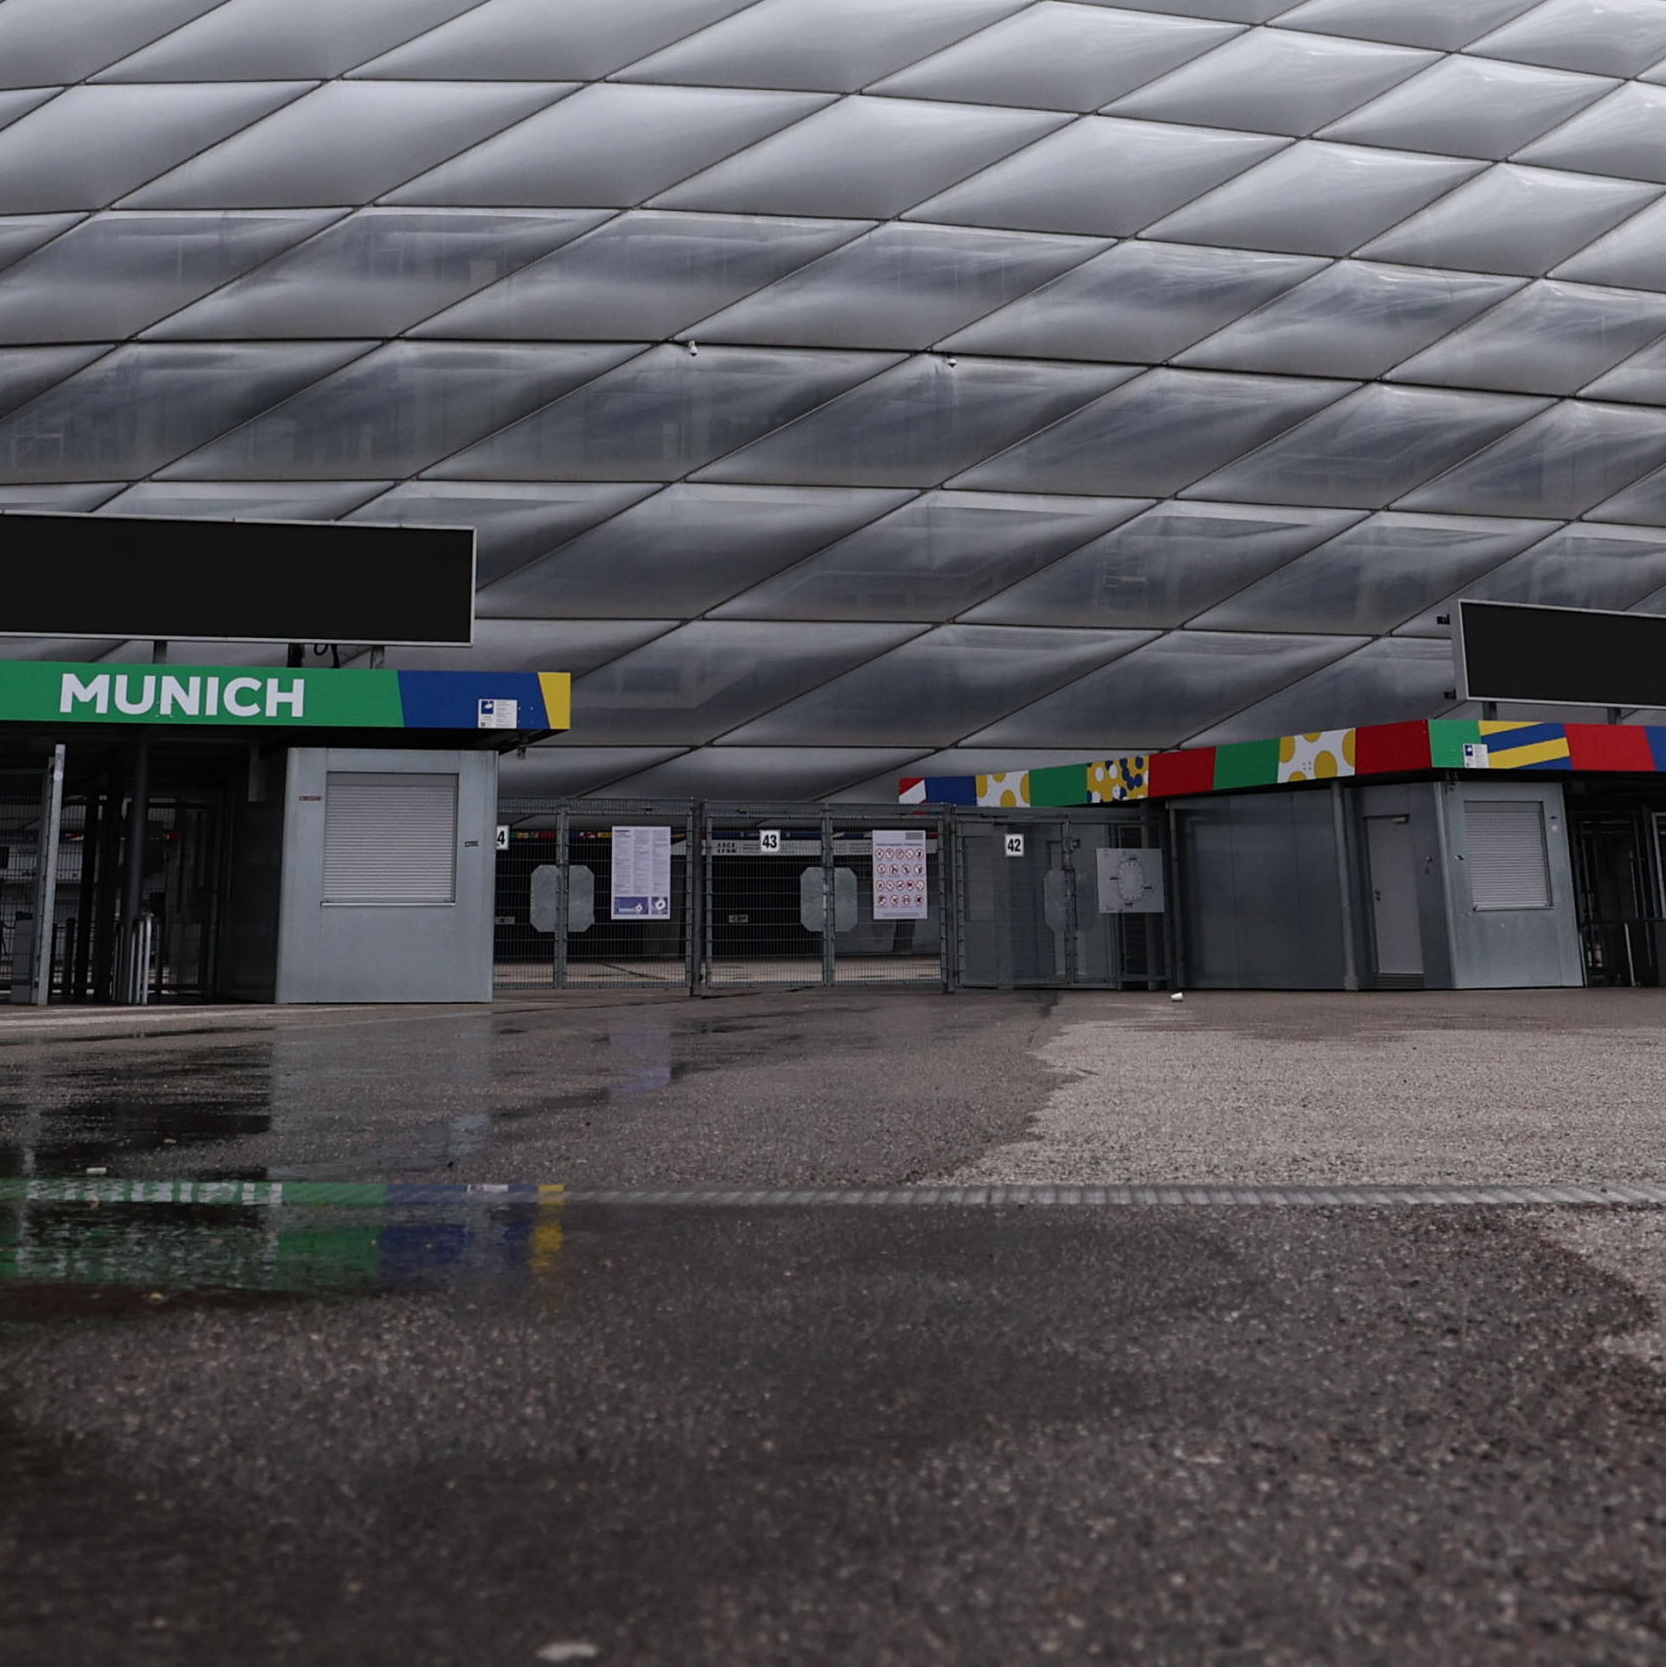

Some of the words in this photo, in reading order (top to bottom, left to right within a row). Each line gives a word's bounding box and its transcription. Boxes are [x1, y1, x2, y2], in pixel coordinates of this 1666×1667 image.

[59, 673, 305, 718] MUNICH
[497, 830, 506, 845] 4
[762, 834, 777, 849] 43
[1007, 838, 1021, 852] 42
